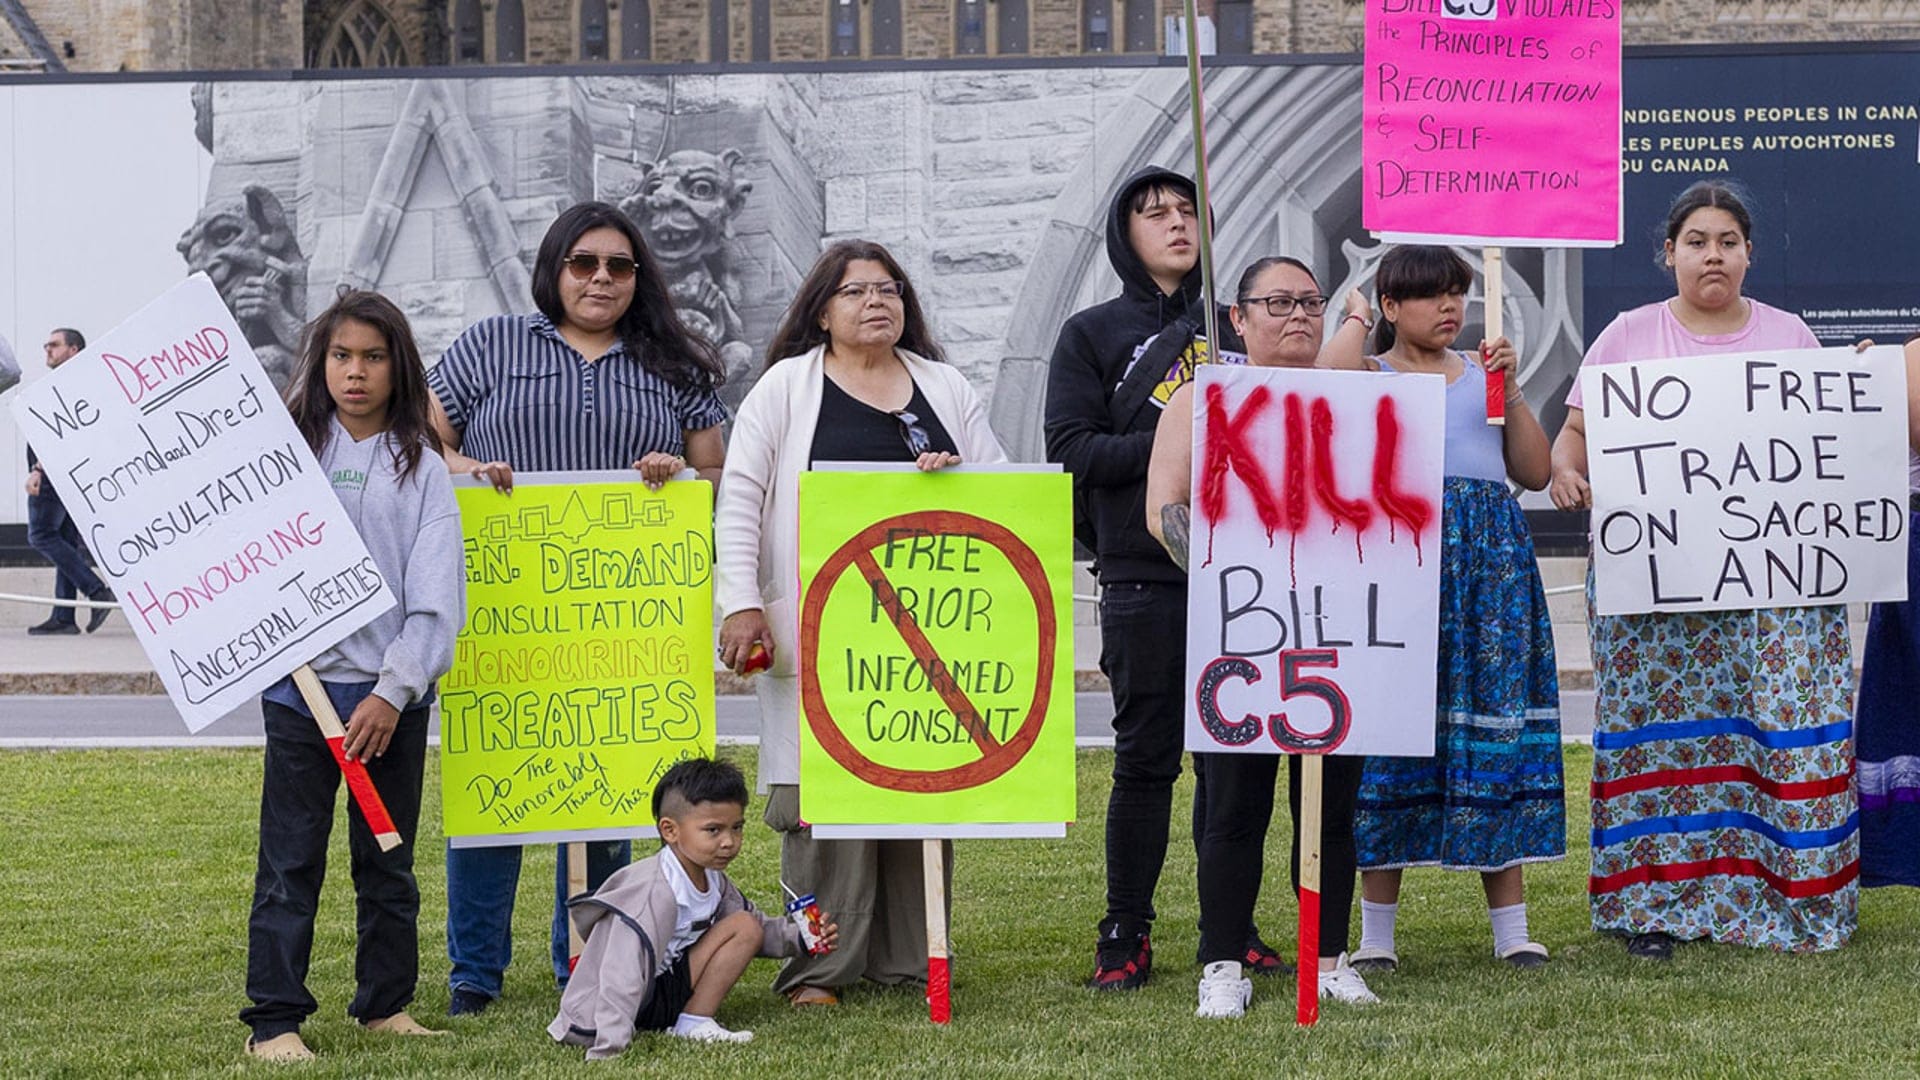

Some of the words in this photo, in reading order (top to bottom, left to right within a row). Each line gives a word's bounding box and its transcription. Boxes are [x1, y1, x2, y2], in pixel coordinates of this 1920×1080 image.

[1420, 20, 1549, 59] PRINCIPLES
[1570, 40, 1602, 59] of
[1378, 62, 1602, 104] RECONCILIATION
[1414, 114, 1493, 152] SELF-
[1623, 137, 1652, 151] ES
[1660, 136, 1744, 151] PEUPLES
[1752, 134, 1896, 150] AUTOCHTONES
[1624, 108, 1736, 123] NDIGENOUS
[1744, 107, 1830, 121] PEOPLES
[1837, 106, 1858, 120] IN
[1376, 160, 1580, 199] DETERMINATION
[1651, 157, 1730, 172] CANADA
[28, 385, 100, 440] We
[102, 325, 229, 405] DEMAND
[1601, 366, 1691, 421] NO
[1745, 361, 1883, 414] FREE
[177, 373, 265, 450] Direct
[165, 435, 191, 462] and
[1200, 382, 1435, 568] KILL
[1602, 435, 1845, 496] TRADE
[90, 442, 303, 578] CONSULTATION
[1600, 509, 1678, 555] ON
[1718, 495, 1903, 542] SACRED
[127, 511, 327, 635] HONOURING
[540, 530, 712, 593] DEMAND
[884, 528, 983, 573] FREE
[1648, 543, 1848, 605] LAND
[169, 608, 307, 692] ANCESTRAL
[278, 557, 383, 616] TREATIES
[456, 596, 684, 637] ONSULTATION
[870, 579, 993, 633] PRIOR
[1219, 565, 1405, 657] BILL
[446, 636, 690, 688] HONOURING
[846, 648, 1014, 694] INFORMED
[440, 680, 701, 754] TREATIES
[866, 700, 1020, 744] CONSENT
[1196, 648, 1352, 755] C5
[466, 774, 513, 814] Do
[513, 752, 558, 782] The
[610, 788, 650, 816] This
